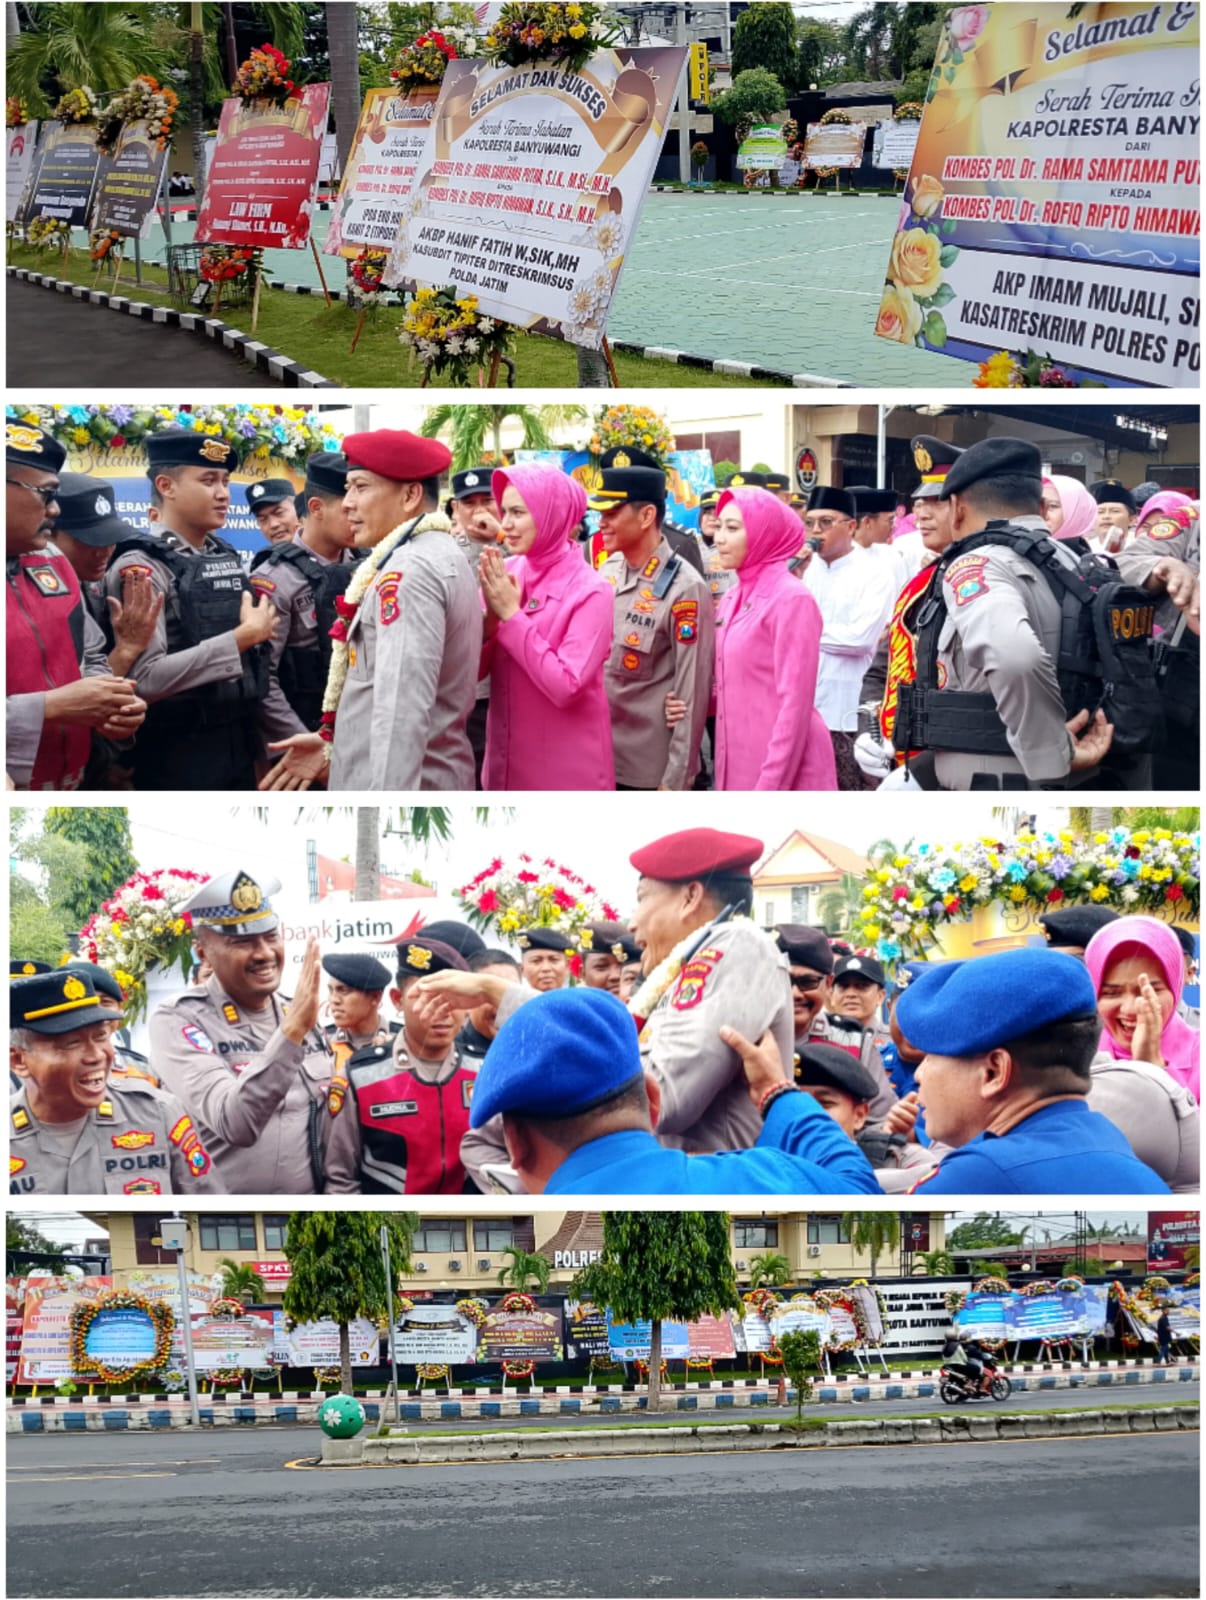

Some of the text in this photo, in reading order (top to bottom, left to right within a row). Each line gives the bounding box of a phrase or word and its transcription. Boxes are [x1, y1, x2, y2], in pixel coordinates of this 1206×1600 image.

[1045, 2, 1197, 61] Selamat &
[471, 71, 606, 119] SELAMAT DAN SUKSES
[1035, 88, 1091, 114] Serah
[1101, 84, 1176, 111] Terima
[533, 119, 573, 138] Jabatan
[1008, 117, 1129, 138] KAPOLRESTA
[463, 139, 582, 157] KAPOLRESTA BANYUWANGI
[1125, 142, 1150, 151] DARI
[943, 156, 990, 180] KOMBES
[993, 157, 1015, 180] POL
[1020, 159, 1037, 179] Dr.
[1042, 158, 1082, 181] RAMA
[1087, 159, 1168, 185] SAMTAMA
[1110, 188, 1152, 199] KEPADA
[942, 196, 990, 218] KOMBES
[993, 198, 1016, 220] POL
[1020, 200, 1037, 221] Dr.
[1042, 200, 1081, 225] ROFIQ
[1086, 203, 1130, 230] RIPTO
[418, 226, 445, 243] AKBP
[447, 231, 480, 250] HANIF
[480, 236, 514, 257] FATIH
[412, 243, 575, 291] KASUBDIT TIPITER DITRESKRIMSUS
[449, 267, 509, 293] POLDA JATIM
[993, 270, 1025, 296] AKP
[1029, 275, 1083, 307] IMAM
[1088, 284, 1170, 326] MUJALI,
[960, 299, 1086, 345] KASATRESKRIM
[1091, 322, 1168, 364] POLRES
[625, 612, 656, 629] POLRI
[106, 1154, 166, 1172] POLRI
[260, 1264, 290, 1273] SPKT
